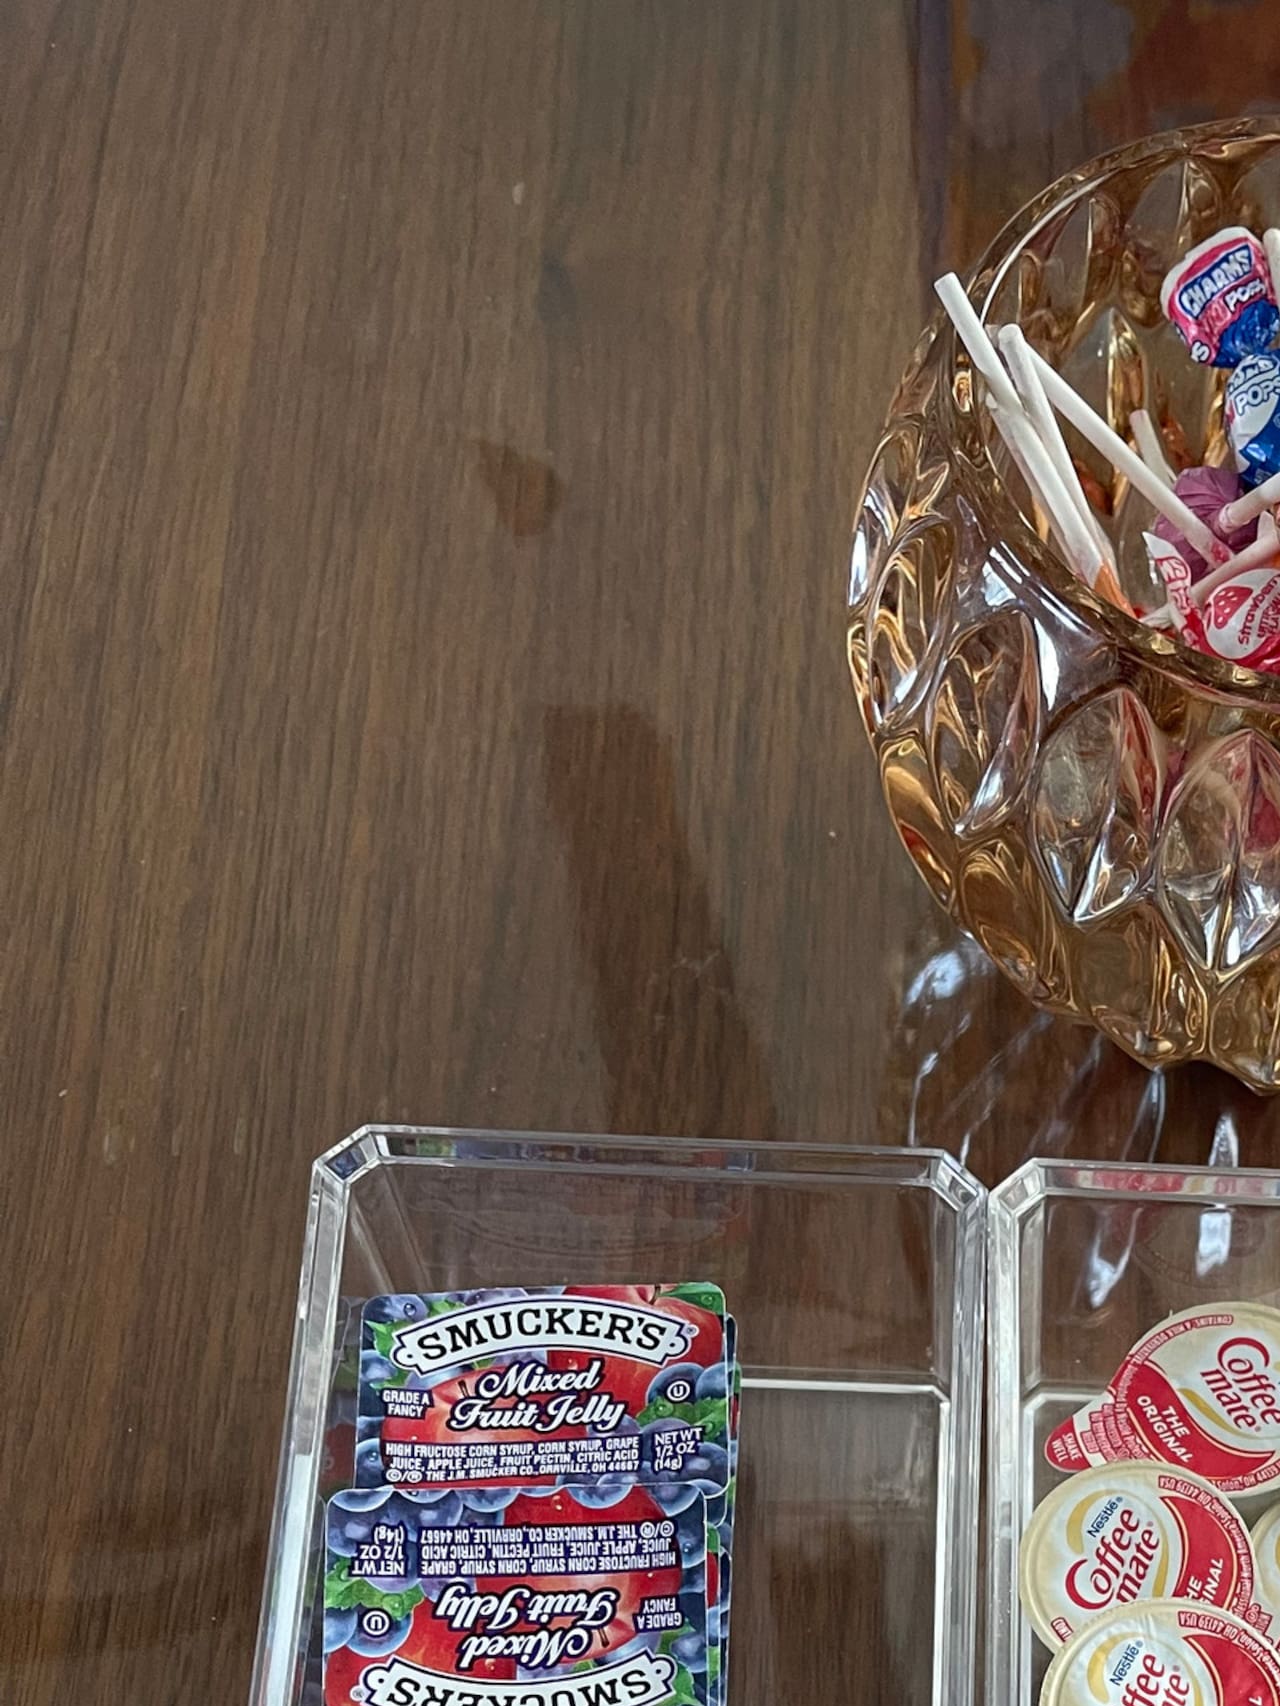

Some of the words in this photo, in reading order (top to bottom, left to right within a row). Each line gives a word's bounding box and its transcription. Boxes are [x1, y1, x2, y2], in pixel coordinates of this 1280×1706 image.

[1180, 248, 1253, 315] CHARMS
[416, 1308, 667, 1361] SMUCKER'S
[382, 1390, 419, 1404] GRADE
[421, 1391, 430, 1405] A
[479, 1361, 603, 1399] Mixed
[1201, 1368, 1256, 1429] mate
[387, 1404, 424, 1417] FANCY
[451, 1399, 540, 1431] Fruit
[538, 1396, 625, 1432] Jelly
[1137, 1395, 1194, 1463] ORIGINAL
[1161, 1406, 1190, 1438] THE
[654, 1431, 680, 1445] NET
[681, 1427, 702, 1442] WT
[655, 1445, 673, 1458] 1/2
[676, 1442, 695, 1454] OZ
[654, 1455, 682, 1471] (14g)
[1065, 1508, 1140, 1610] Coffee
[1116, 1529, 1159, 1603] mate
[436, 1584, 527, 1630] Jelly
[527, 1589, 615, 1624] Fruit
[460, 1629, 589, 1669] Mixed
